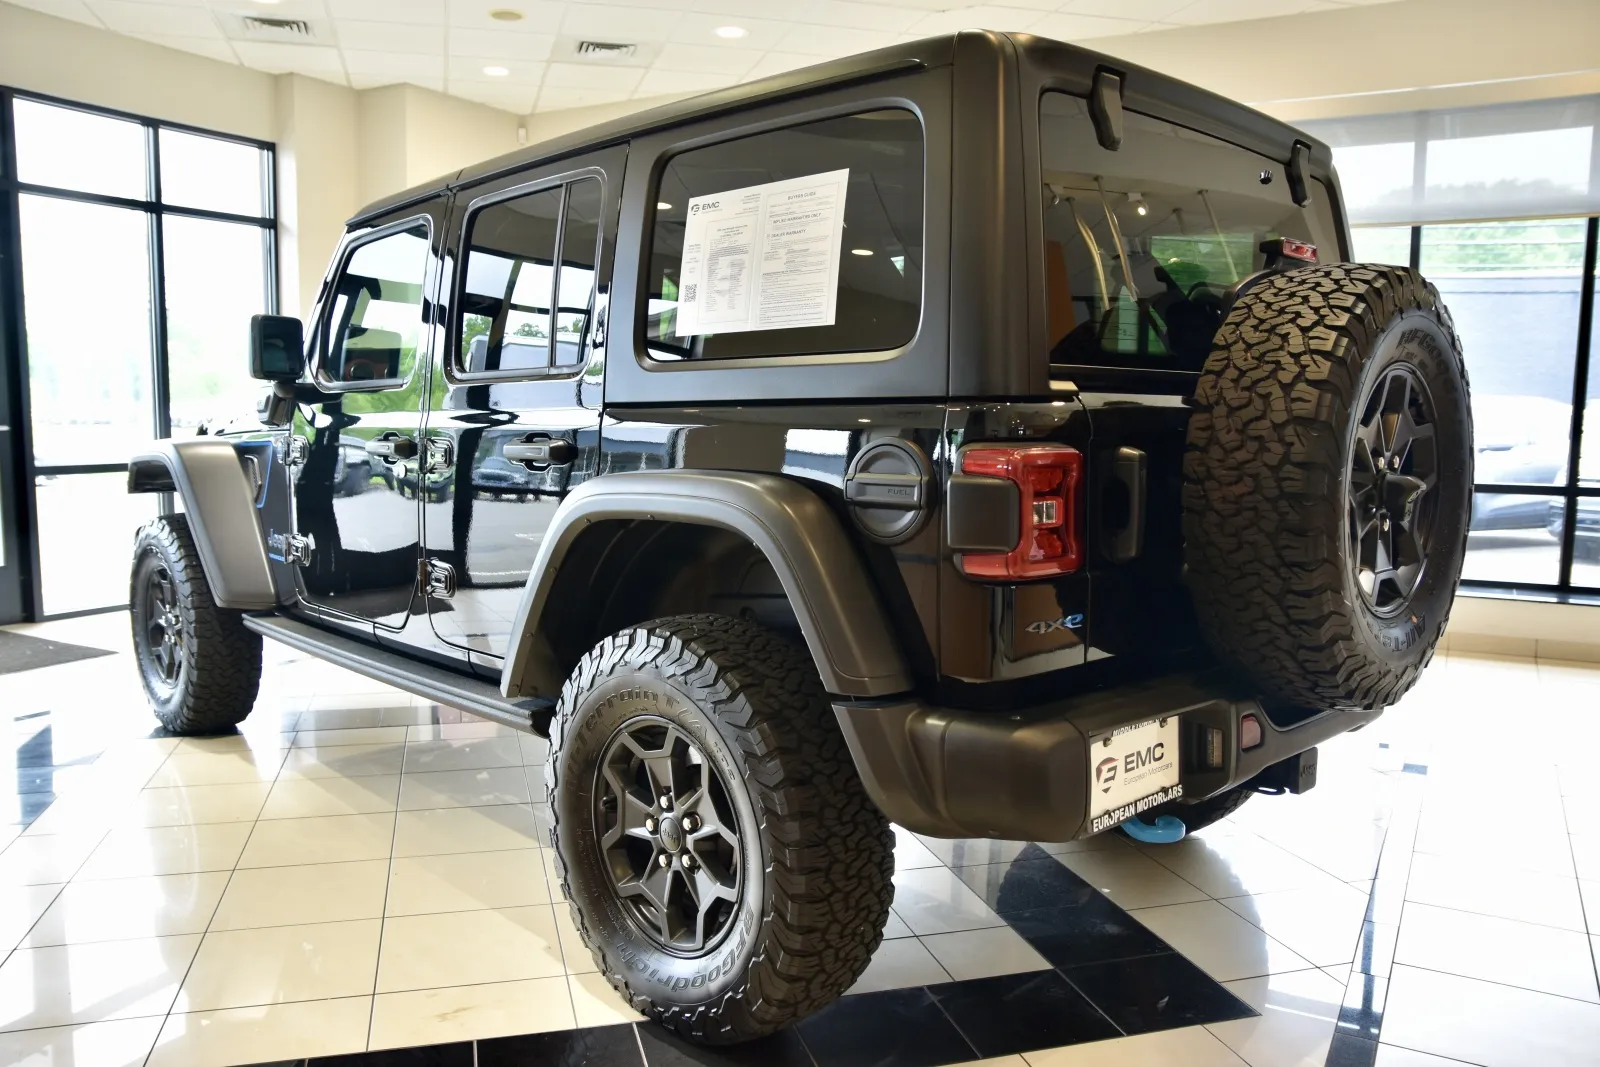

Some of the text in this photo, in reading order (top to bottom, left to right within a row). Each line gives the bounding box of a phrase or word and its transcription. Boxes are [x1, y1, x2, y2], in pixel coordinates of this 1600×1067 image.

[702, 201, 720, 210] EMC
[887, 488, 910, 496] FUEL
[1124, 742, 1164, 773] EMC
[1124, 761, 1173, 786] European Motorcars
[1093, 784, 1183, 832] EUROPEAN MOTORCARS
[616, 903, 755, 992] BFGoodrich
